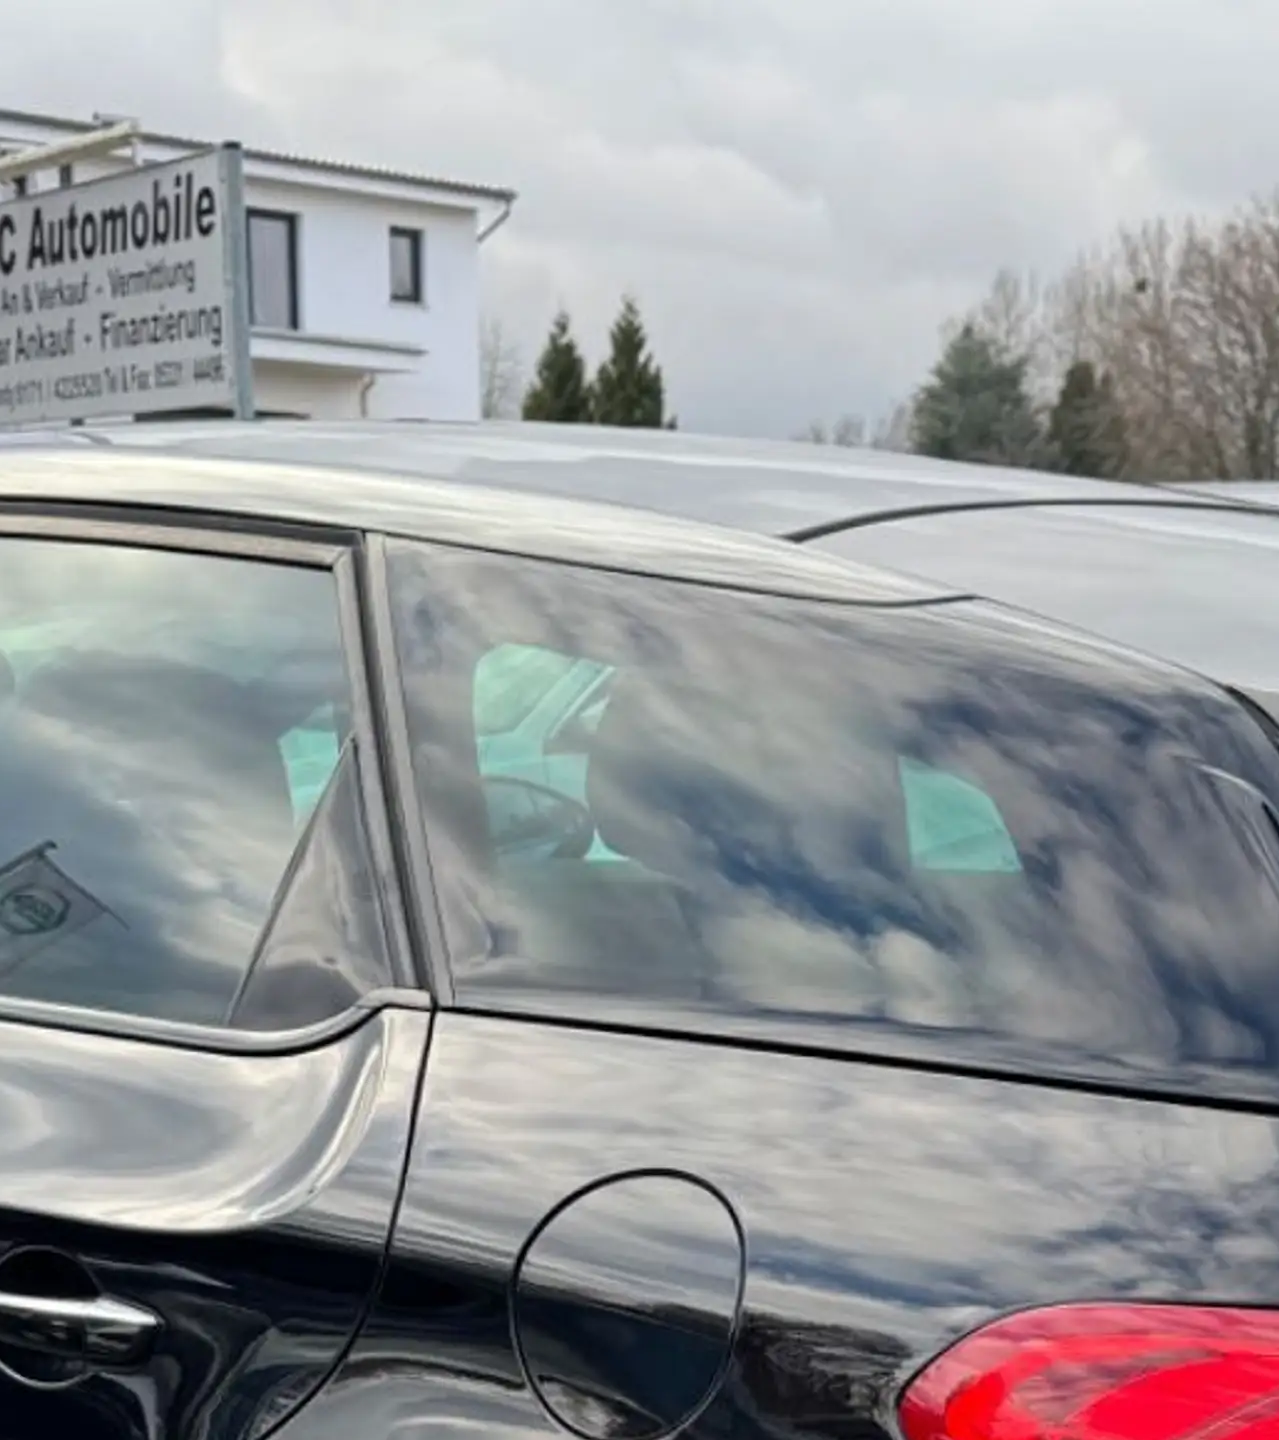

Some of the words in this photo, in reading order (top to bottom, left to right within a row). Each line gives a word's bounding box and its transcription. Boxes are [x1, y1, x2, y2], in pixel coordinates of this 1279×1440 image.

[26, 172, 217, 270] Automobile
[0, 286, 19, 317] An
[35, 272, 89, 311] Verkauf
[106, 257, 196, 299] Vermittlung
[14, 317, 76, 364] Ankauf
[99, 304, 222, 350] Finanzierung
